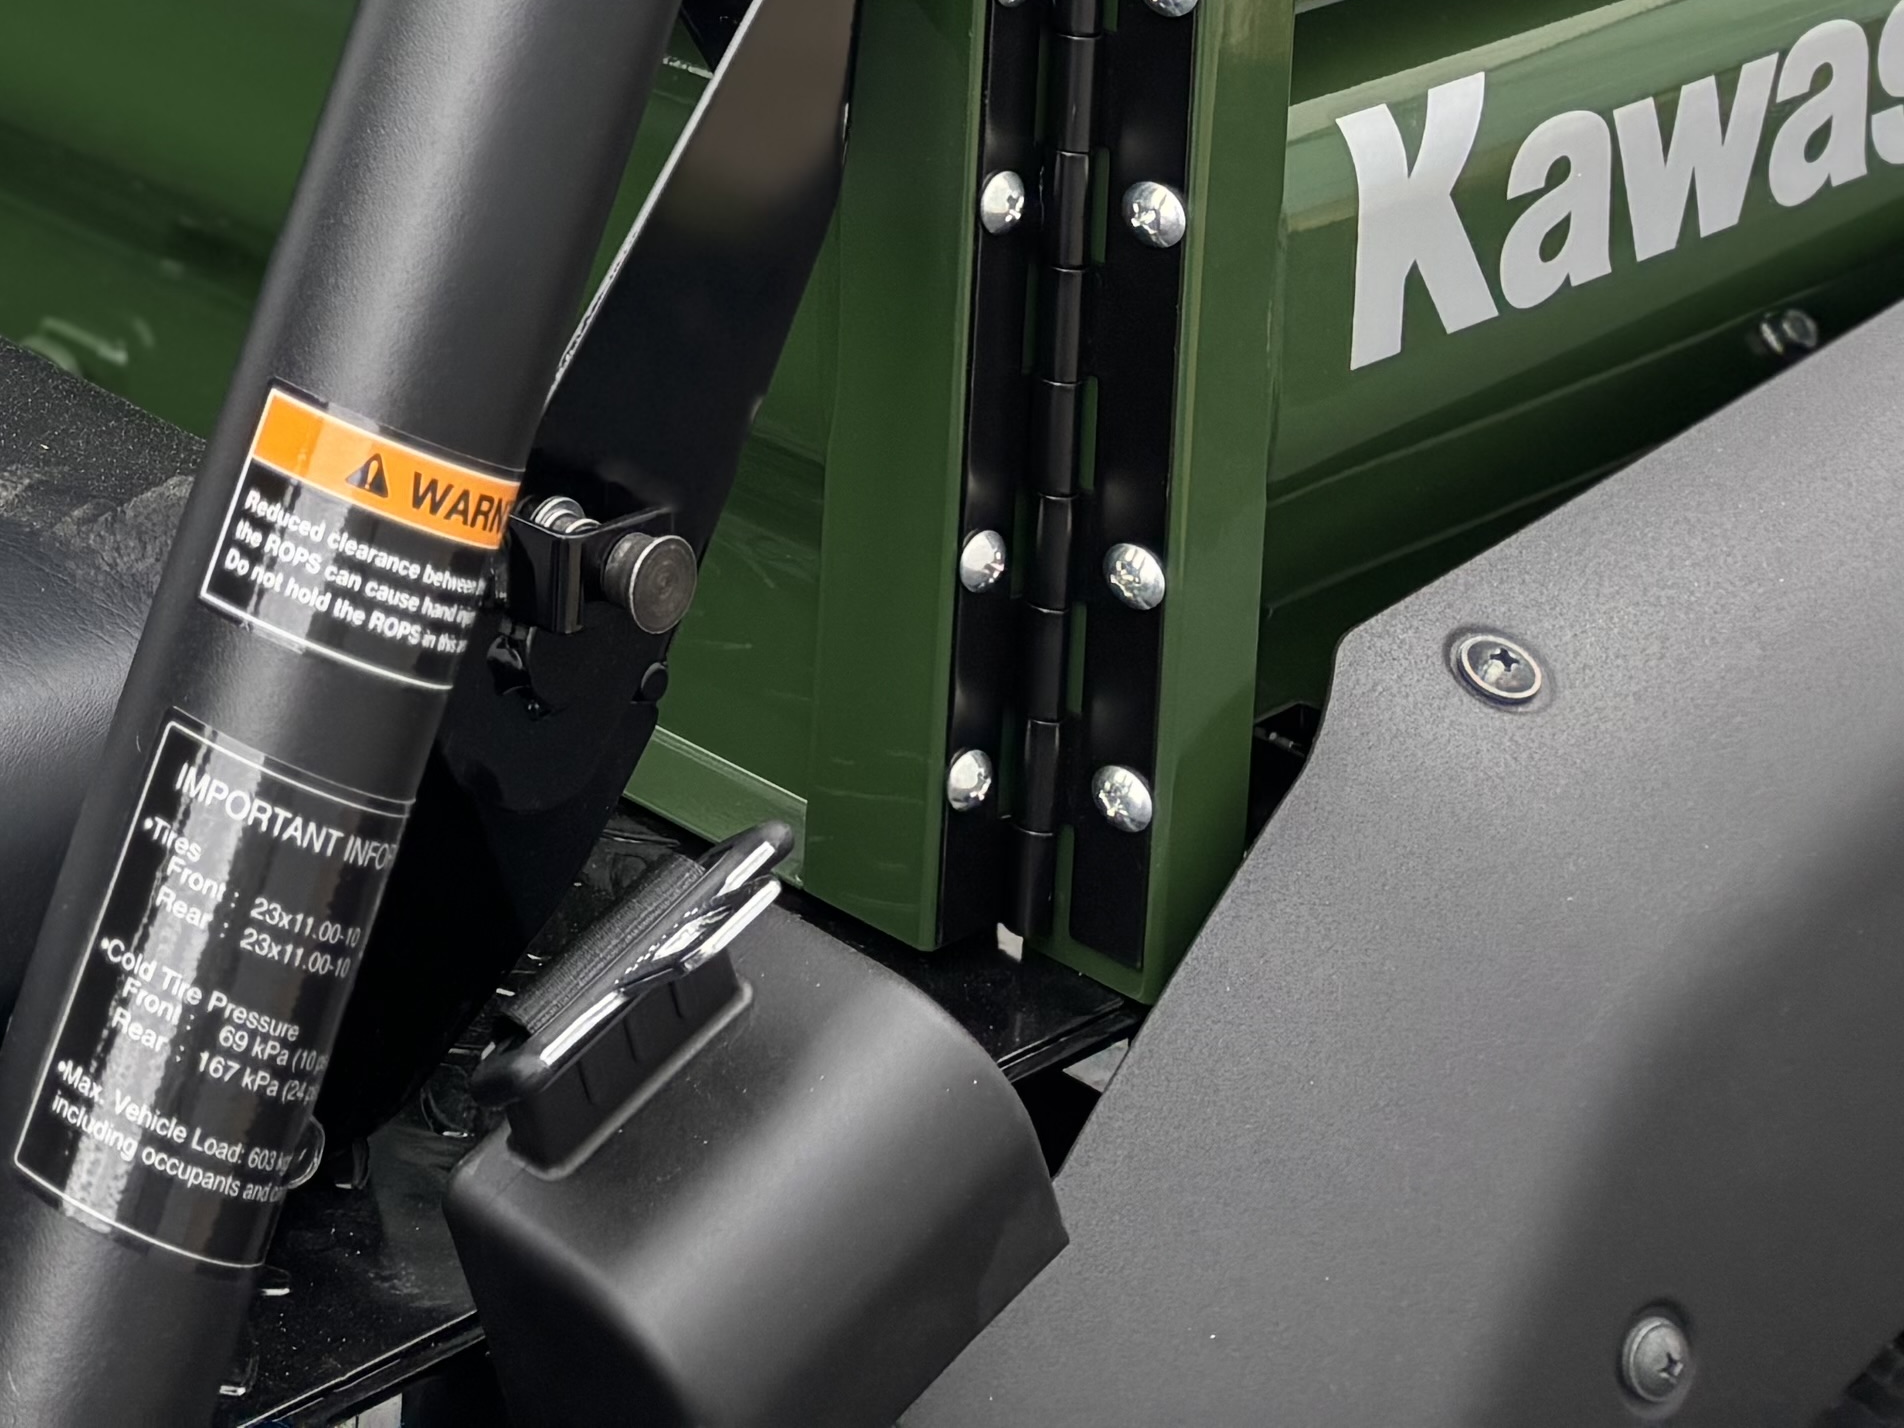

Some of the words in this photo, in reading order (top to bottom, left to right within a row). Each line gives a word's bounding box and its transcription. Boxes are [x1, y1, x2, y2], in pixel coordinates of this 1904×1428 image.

[235, 519, 263, 548] the
[264, 532, 322, 574] ROPS
[324, 565, 362, 592] can
[364, 580, 421, 612] cause
[421, 596, 458, 623] hand
[244, 488, 326, 543] Reduced
[327, 531, 421, 579] clearance
[224, 546, 250, 576] Do
[250, 564, 284, 593] not
[284, 576, 332, 612] hold
[333, 598, 366, 626] the
[368, 609, 422, 645] ROPS
[152, 815, 202, 862] Tires
[175, 760, 344, 857] IMPORTANT
[155, 885, 214, 930] Rear
[239, 927, 351, 978] 23x11.00-10
[165, 855, 226, 902] Front
[250, 897, 361, 948] 23x11.00-10
[106, 938, 157, 983] Cold
[160, 965, 203, 1005] Tire
[207, 990, 300, 1041] Pressure
[122, 976, 182, 1025] Front
[218, 1024, 249, 1052] 69
[251, 1035, 290, 1066] kPa
[111, 1006, 171, 1052] Rear
[198, 1050, 241, 1083] 167
[241, 1066, 280, 1098] kPa
[52, 1090, 139, 1162] including
[141, 1146, 242, 1198] occupants
[242, 1182, 272, 1203] and
[62, 1060, 105, 1105] Max.
[113, 1088, 188, 1143] Vehicle
[191, 1126, 246, 1164] Load:
[248, 1147, 277, 1171] 603
